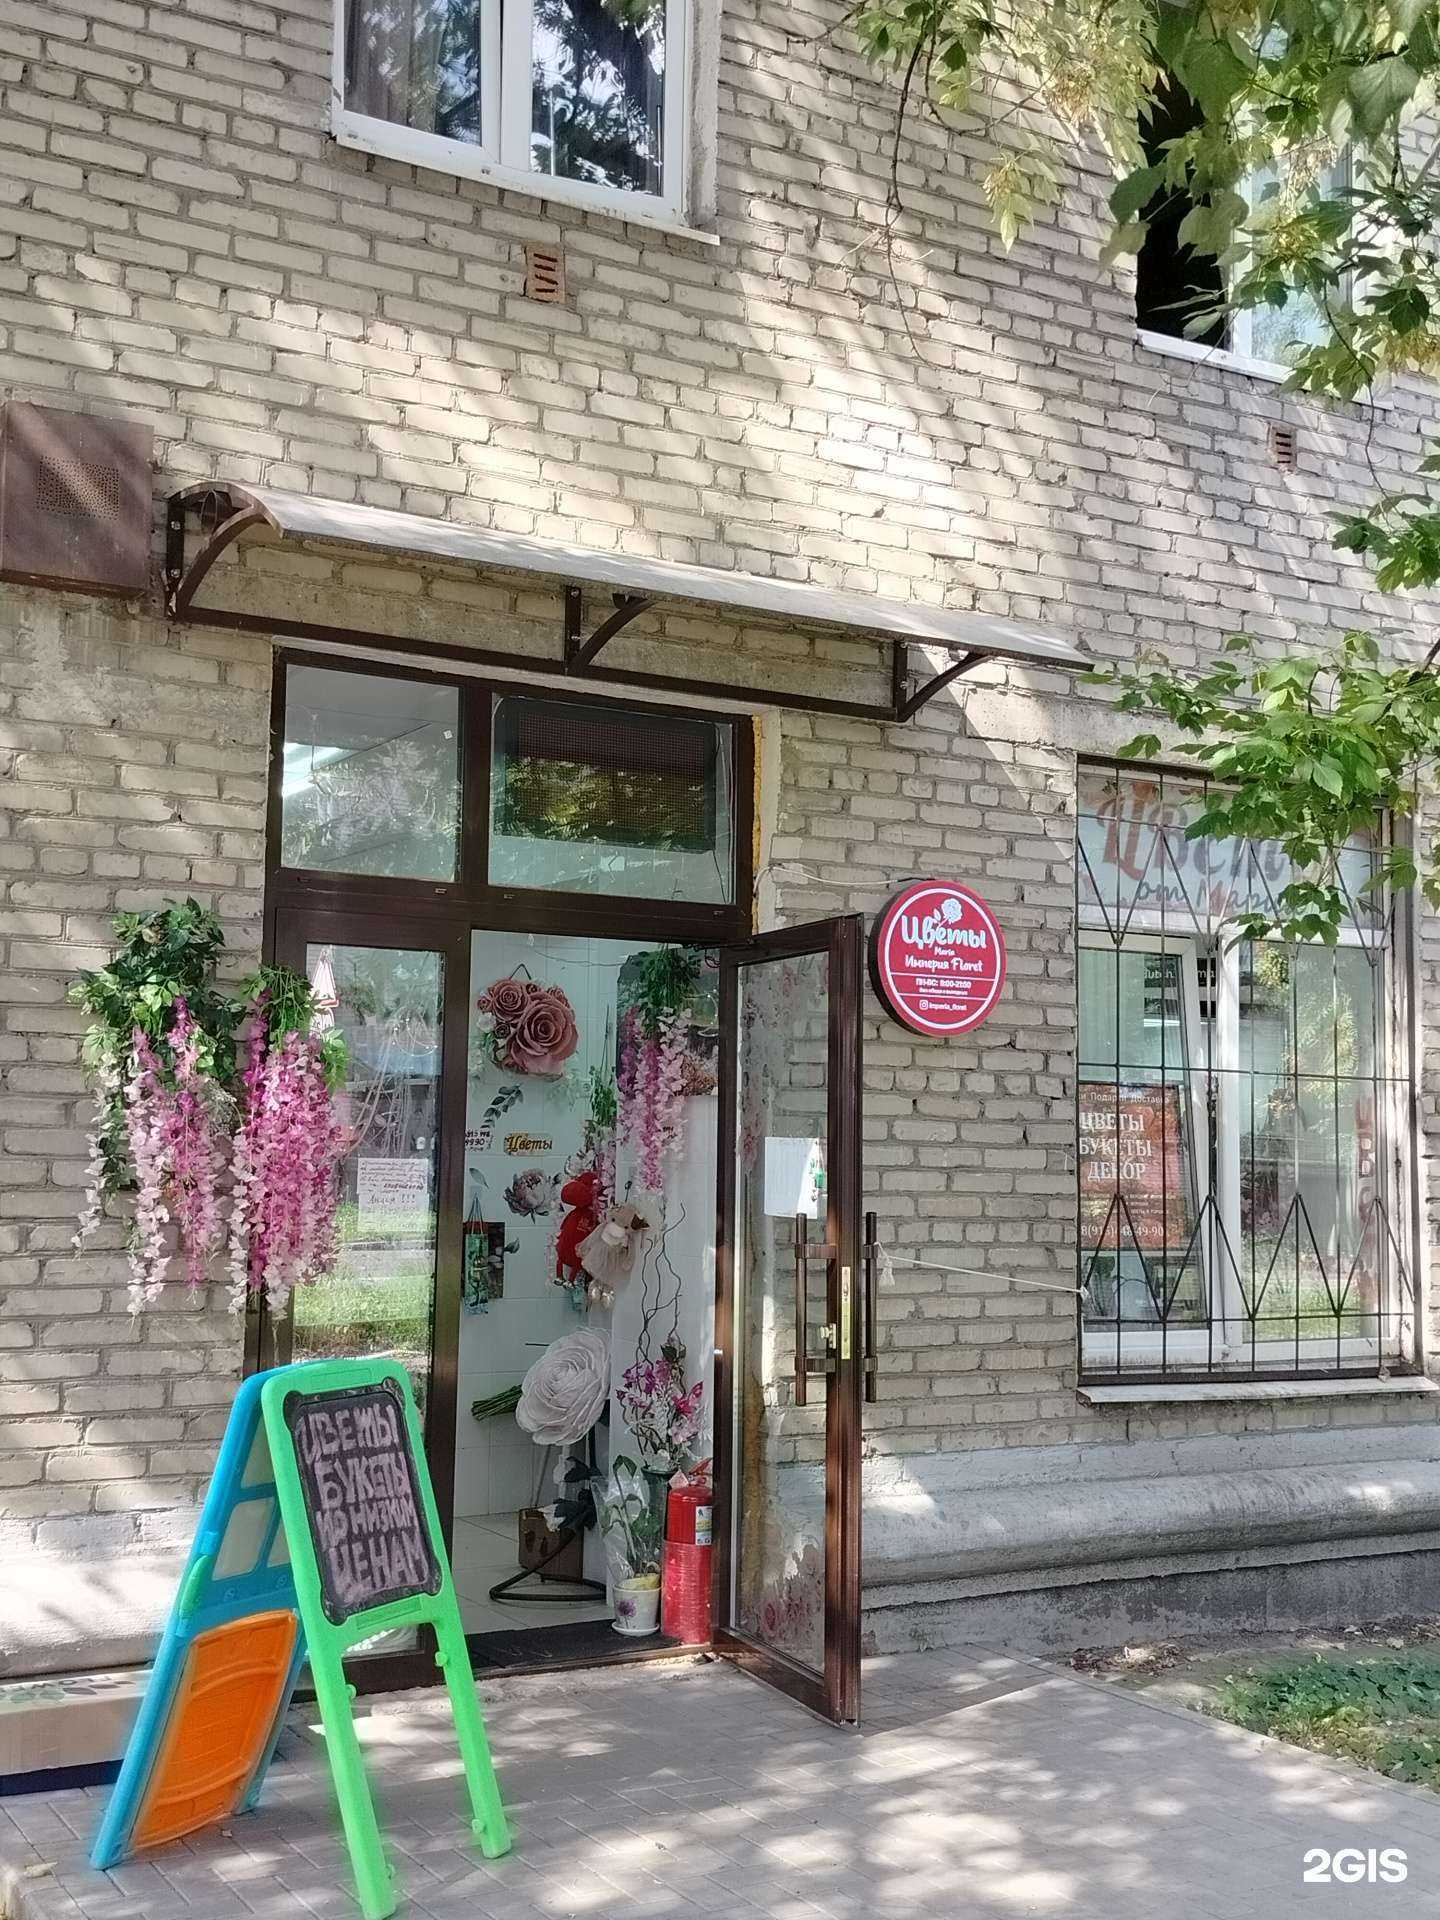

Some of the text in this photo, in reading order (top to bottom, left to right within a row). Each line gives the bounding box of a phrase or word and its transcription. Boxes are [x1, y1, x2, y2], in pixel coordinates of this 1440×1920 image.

[901, 914, 987, 950] Цветы
[905, 954, 983, 973] Империя Floret
[1080, 1112, 1145, 1132] ЦВЕТЫ
[505, 1135, 553, 1152] Цветы
[1087, 1161, 1146, 1181] ДЕКОР
[313, 1452, 412, 1510] БУКЕТЫ
